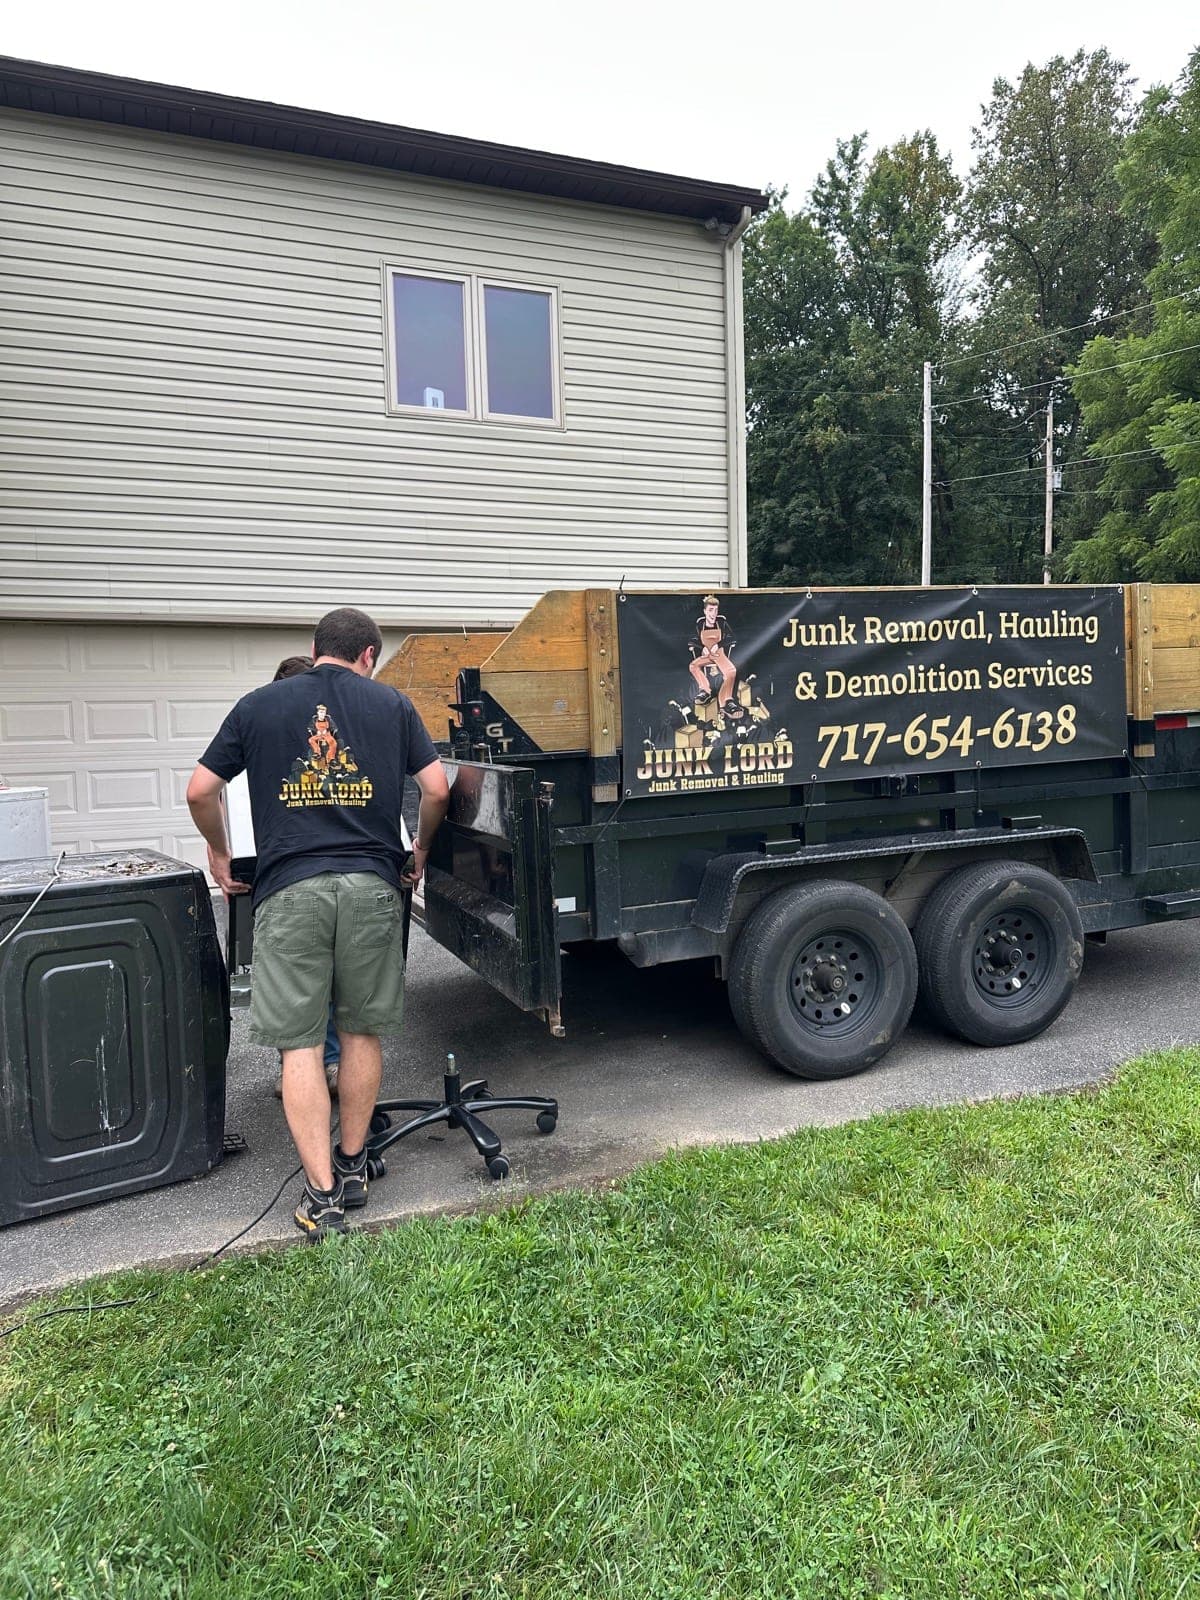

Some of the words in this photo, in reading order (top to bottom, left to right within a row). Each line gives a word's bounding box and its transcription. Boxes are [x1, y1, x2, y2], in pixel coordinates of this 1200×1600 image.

[783, 616, 857, 648] Junk
[864, 611, 993, 645] Removal,
[999, 610, 1099, 643] Hauling
[795, 671, 817, 700] &
[825, 663, 981, 699] Demolition
[988, 660, 1093, 689] Services
[817, 704, 1077, 769] 717-654-6138
[637, 747, 714, 779] JUNK
[724, 741, 793, 773] LORD
[279, 782, 324, 800] JUNK
[328, 783, 373, 799] LORD
[649, 780, 677, 792] Junk
[681, 776, 728, 790] Removal
[732, 774, 739, 786] &
[743, 772, 784, 786] Hauling
